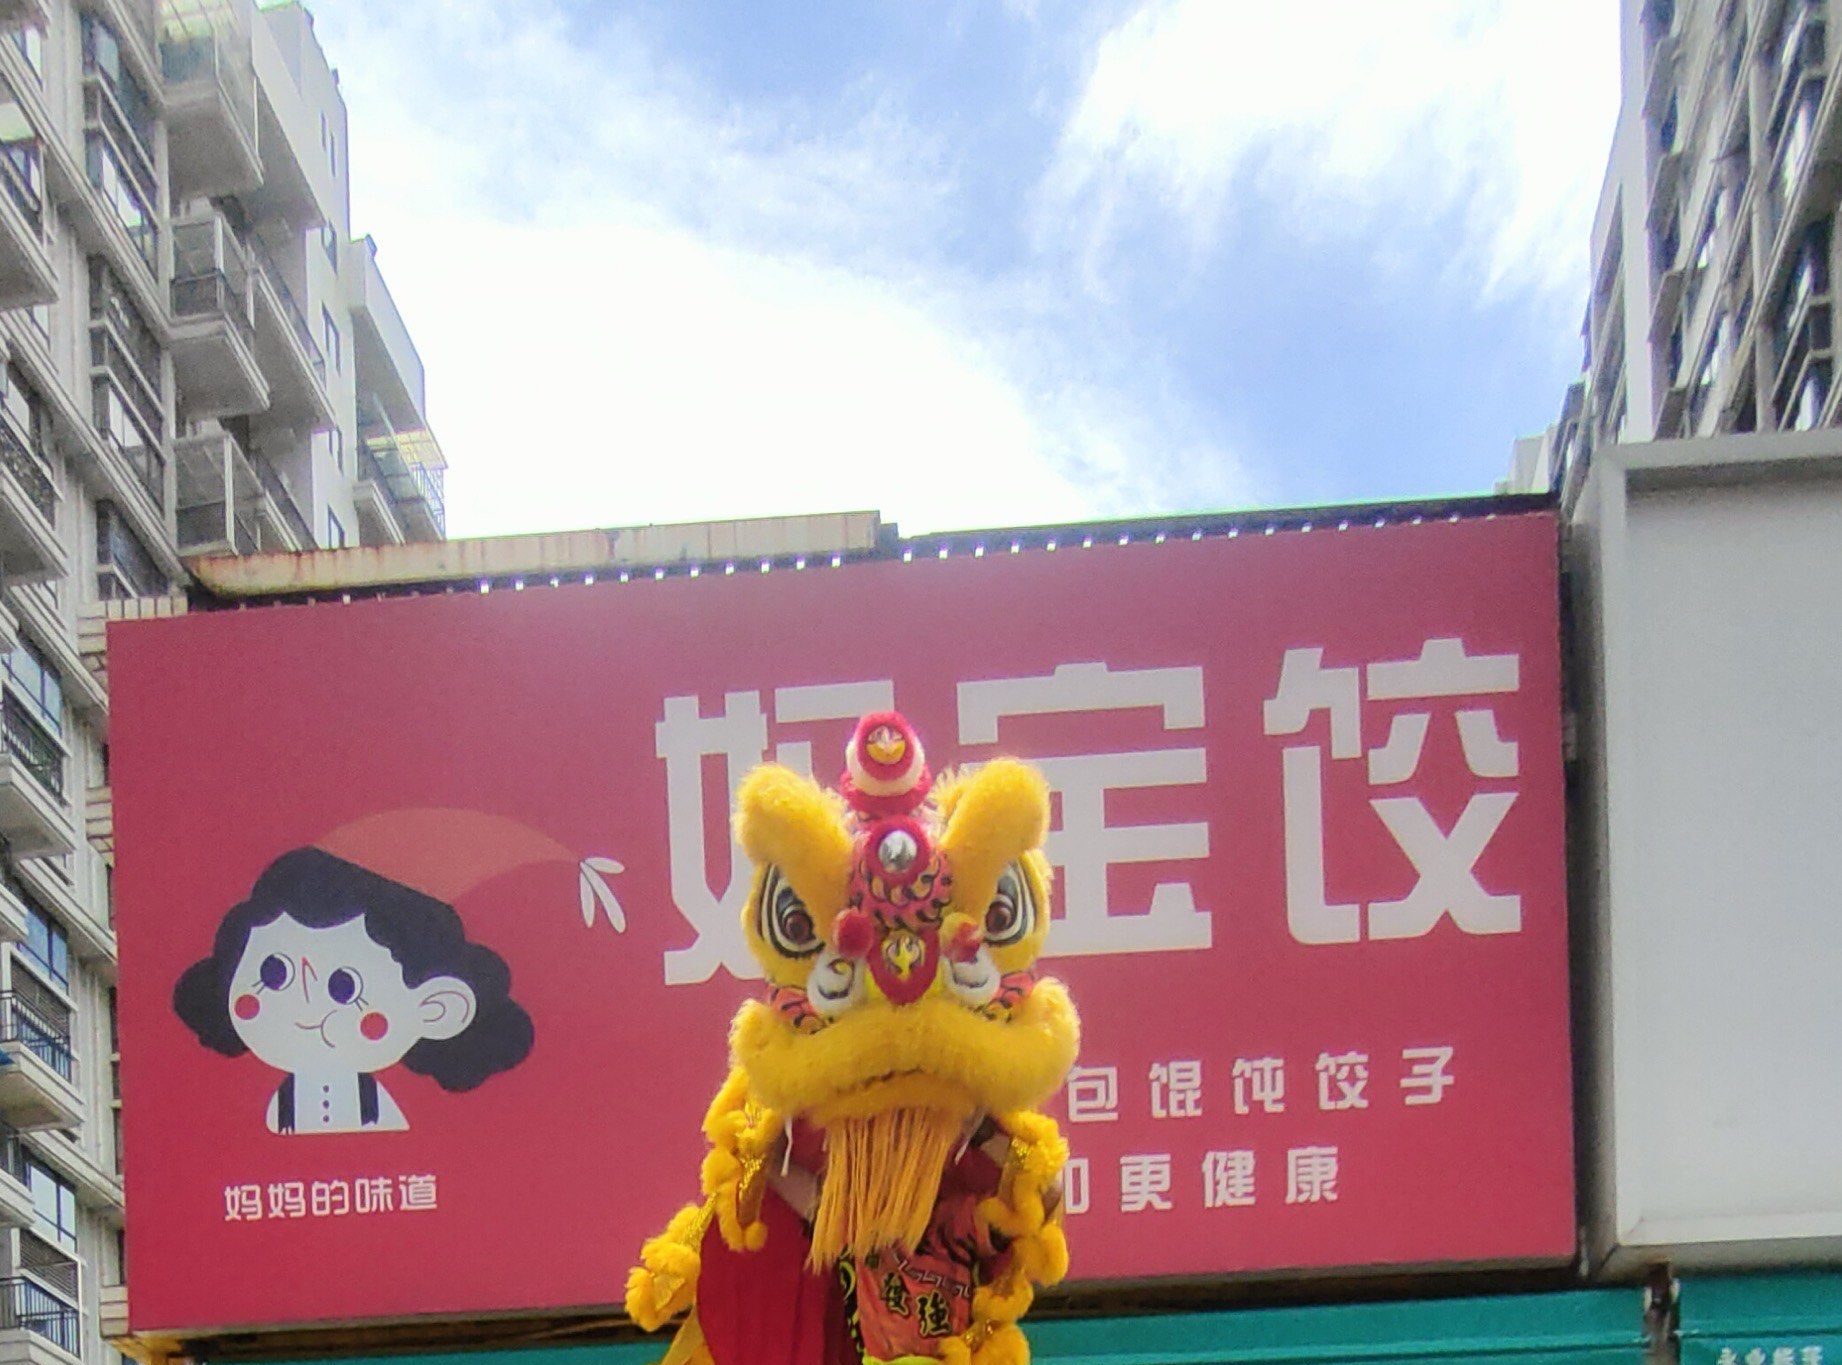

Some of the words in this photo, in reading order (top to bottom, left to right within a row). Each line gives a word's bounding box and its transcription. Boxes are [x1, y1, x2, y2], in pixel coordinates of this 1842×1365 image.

[224, 1174, 438, 1222] 妈妈的味道
